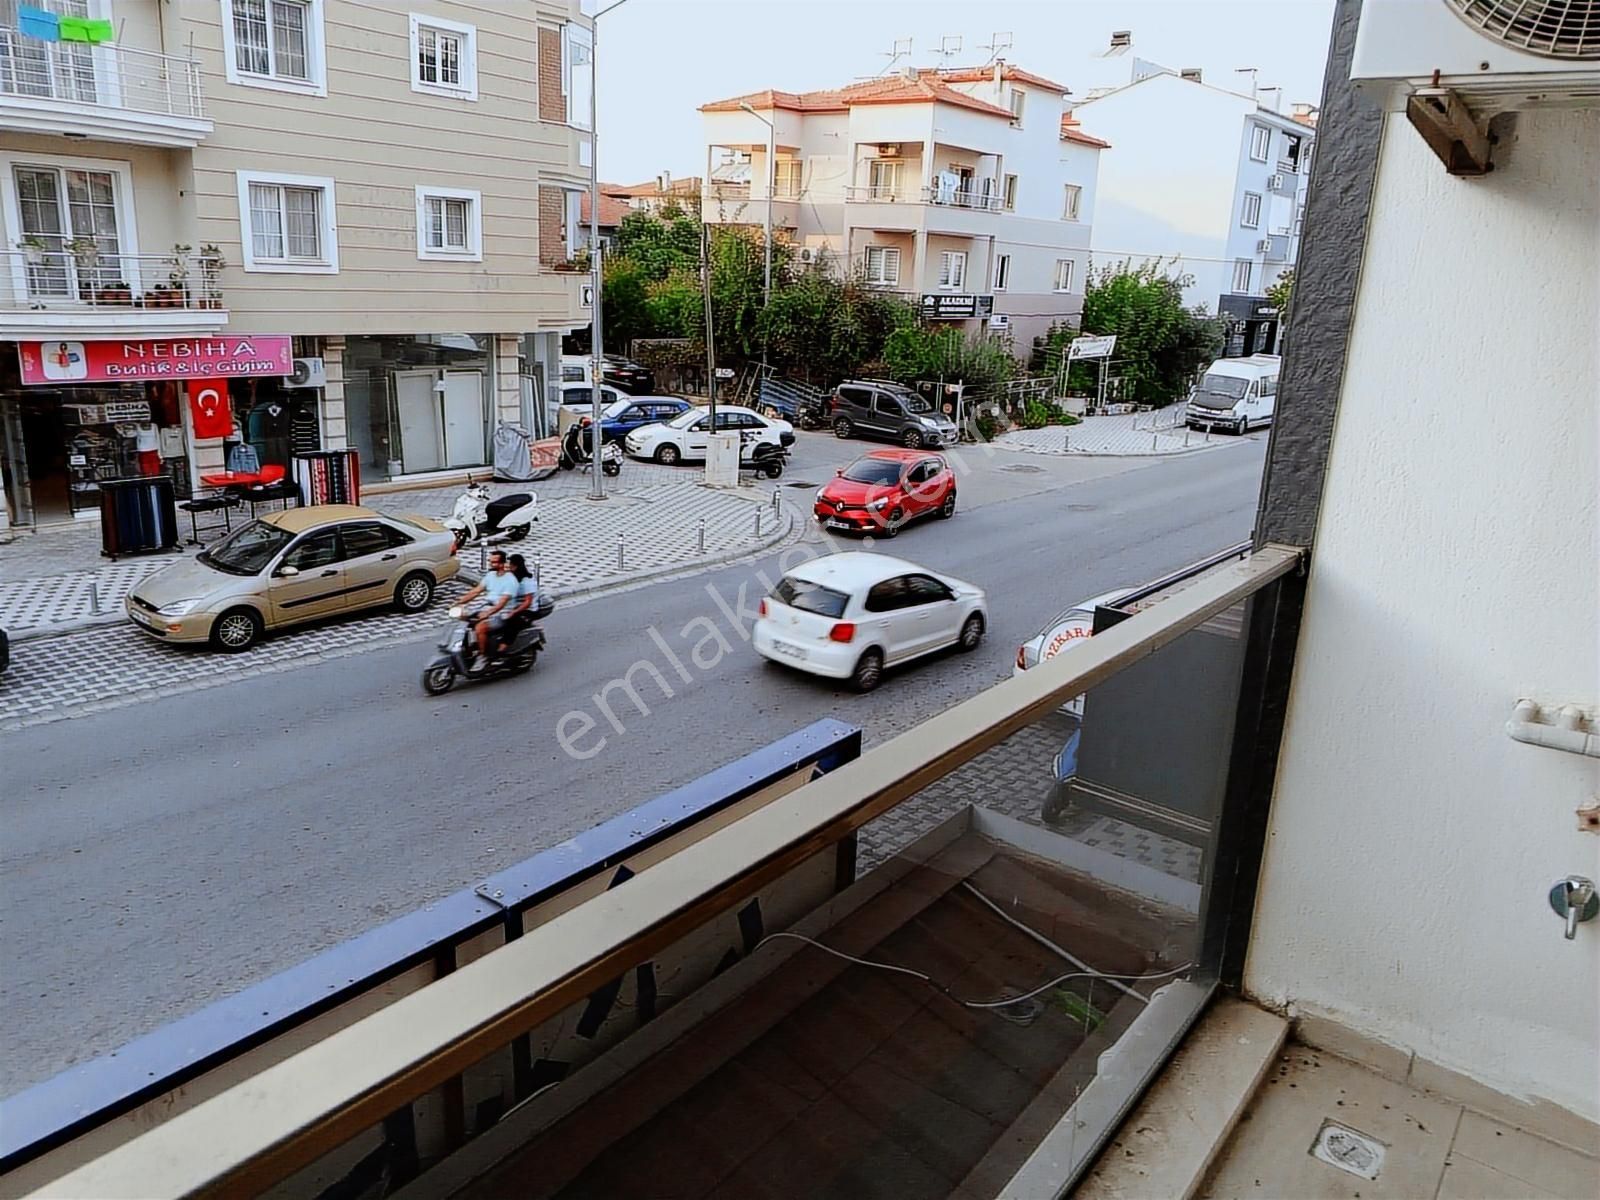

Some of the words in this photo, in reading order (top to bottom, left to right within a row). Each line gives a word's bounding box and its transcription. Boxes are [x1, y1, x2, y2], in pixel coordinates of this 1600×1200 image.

[124, 341, 256, 358] NEBİHA
[106, 362, 171, 375] Butik
[175, 362, 190, 373] &
[216, 360, 274, 374] Giyim
